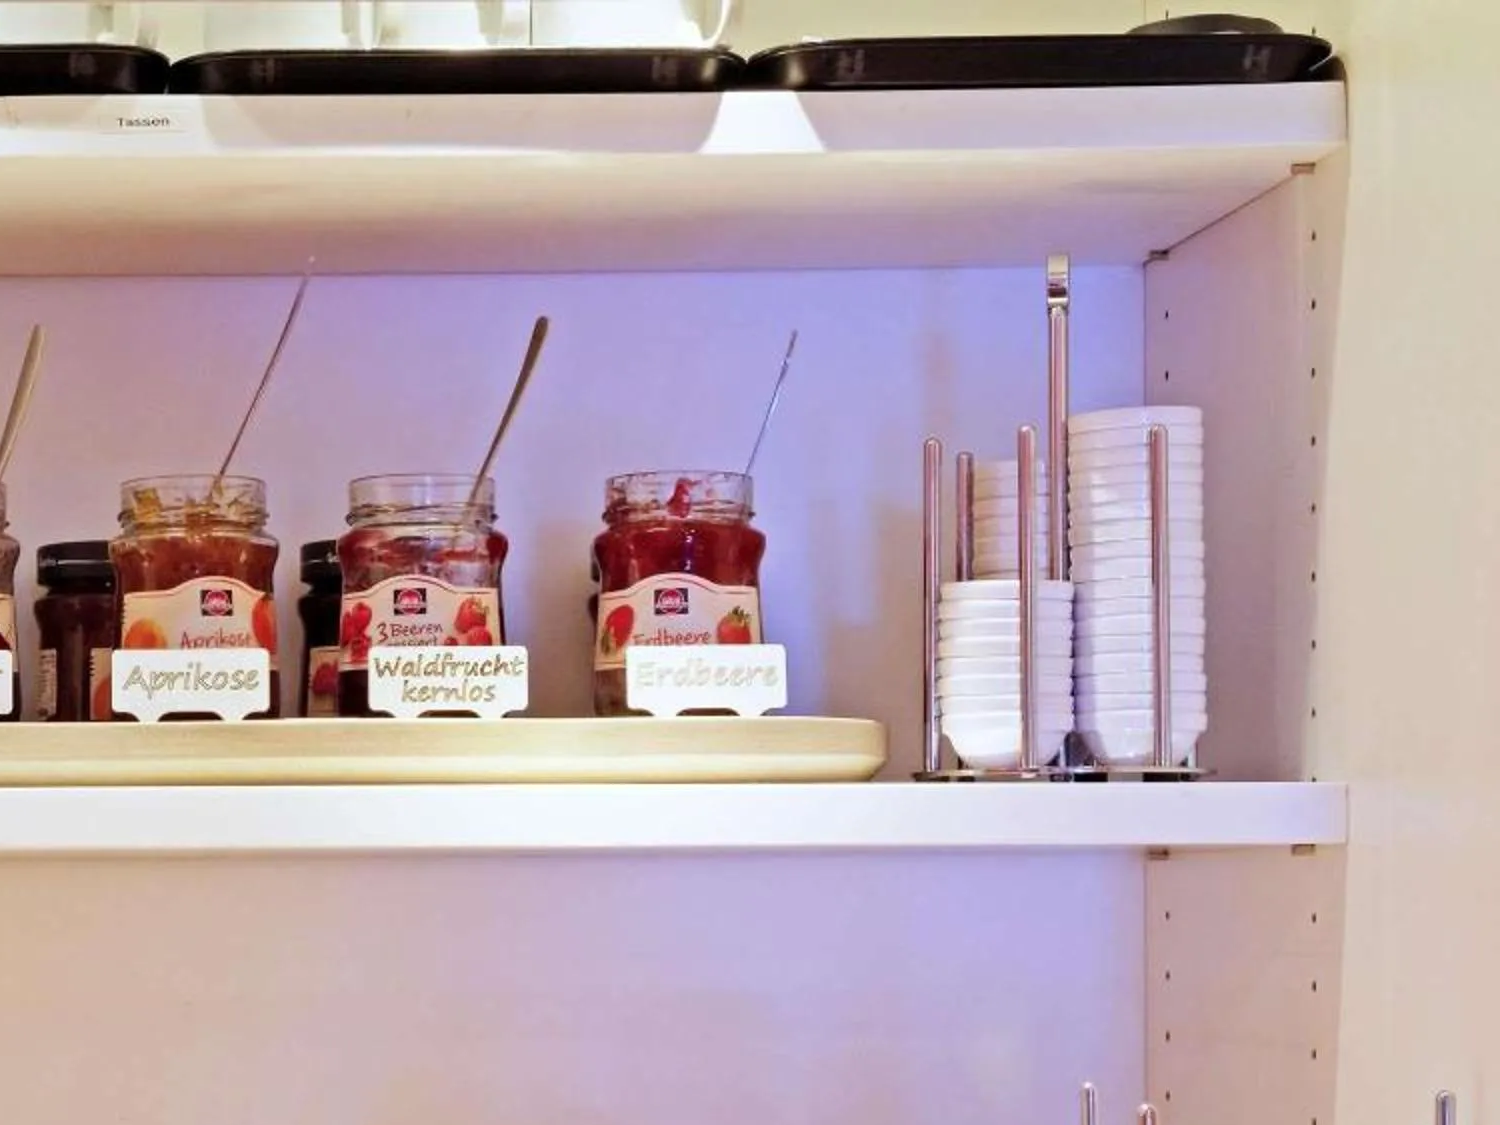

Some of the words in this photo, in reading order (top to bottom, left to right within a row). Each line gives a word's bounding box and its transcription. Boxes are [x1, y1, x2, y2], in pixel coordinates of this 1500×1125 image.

[116, 117, 170, 128] Tassen
[376, 622, 389, 644] 3
[390, 623, 444, 637] Beeren
[374, 653, 526, 678] Waldfrucht
[636, 657, 779, 688] Erdbeere
[121, 662, 261, 700] Aprikose
[401, 680, 497, 703] kernlos
